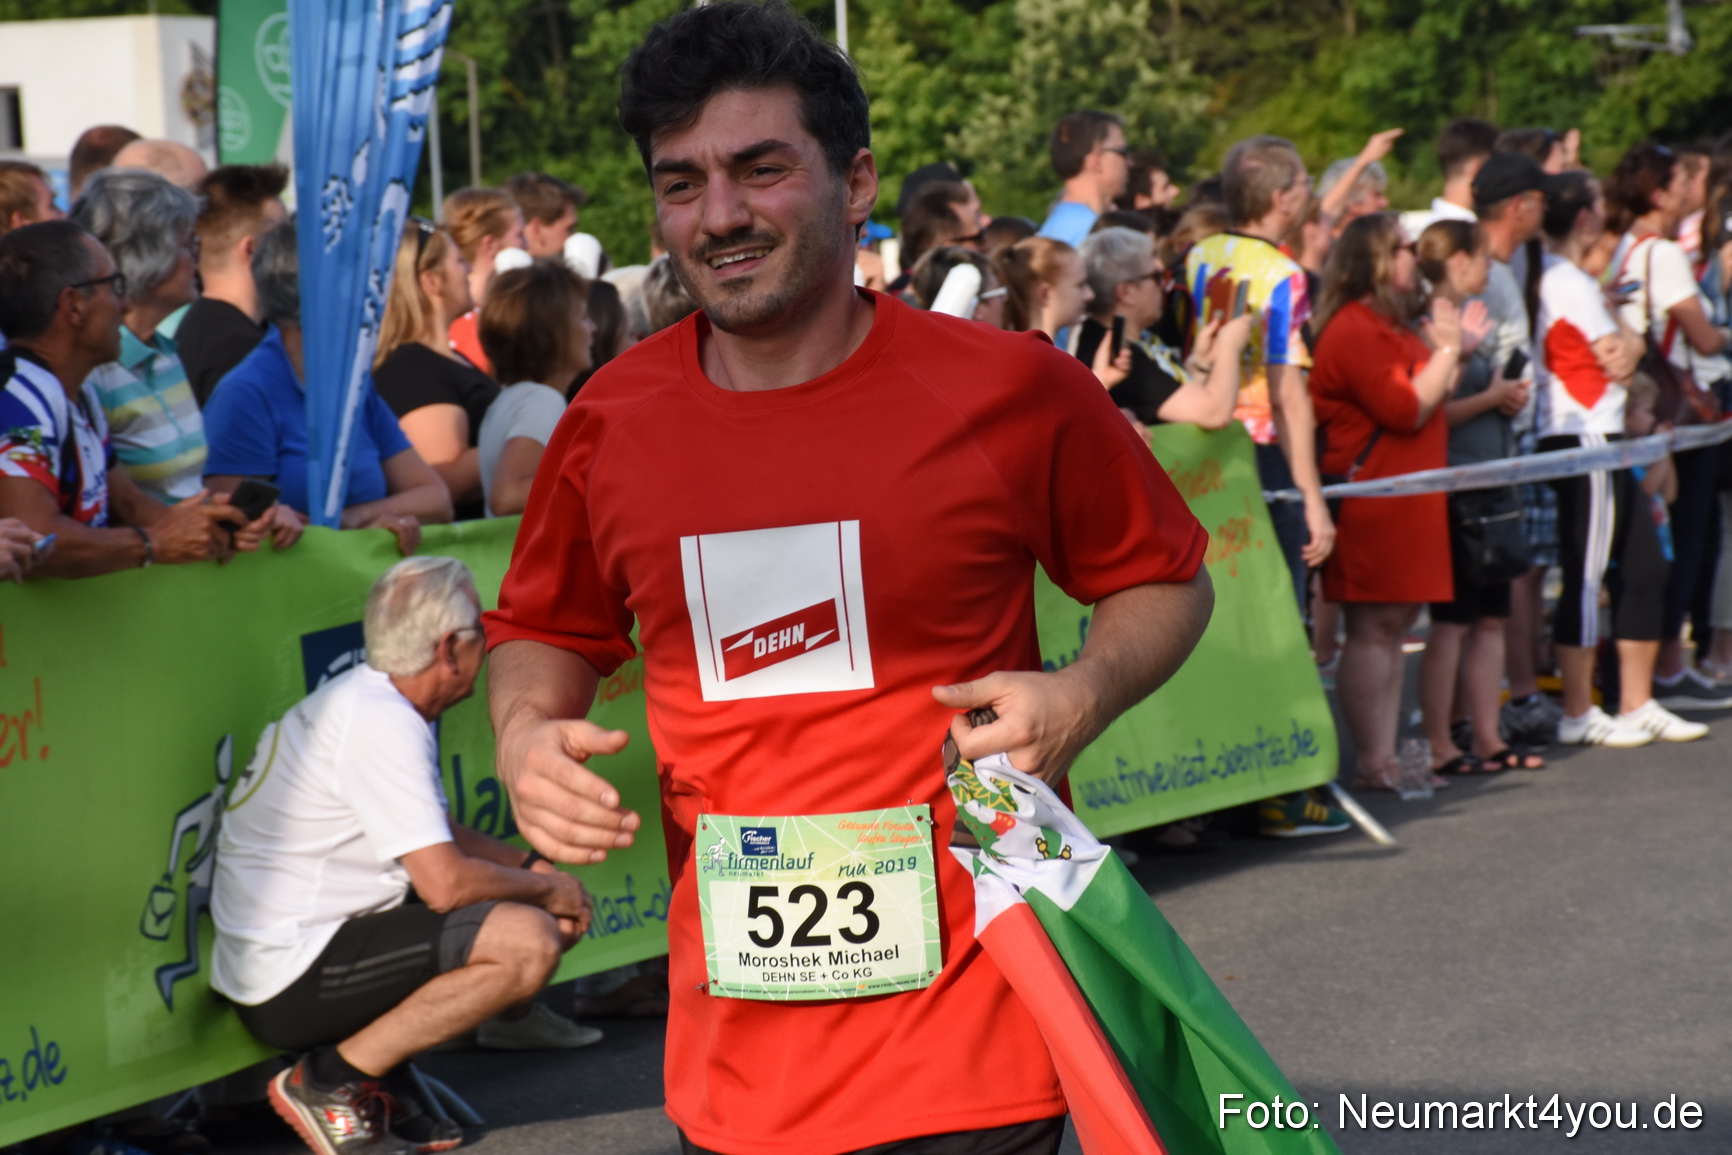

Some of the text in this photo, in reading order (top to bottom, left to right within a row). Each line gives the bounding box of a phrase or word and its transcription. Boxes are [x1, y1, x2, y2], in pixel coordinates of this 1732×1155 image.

[753, 622, 805, 659] DEHN
[0, 676, 50, 768] er!
[728, 852, 815, 870] firmenlauf
[838, 856, 917, 877] run 2019
[747, 881, 880, 948] 523
[738, 944, 900, 968] Moroshek Michael
[762, 971, 796, 982] DEHN
[800, 971, 816, 982] SE
[832, 970, 849, 980] Co
[853, 967, 873, 979] KG
[0, 1024, 68, 1103] z.de
